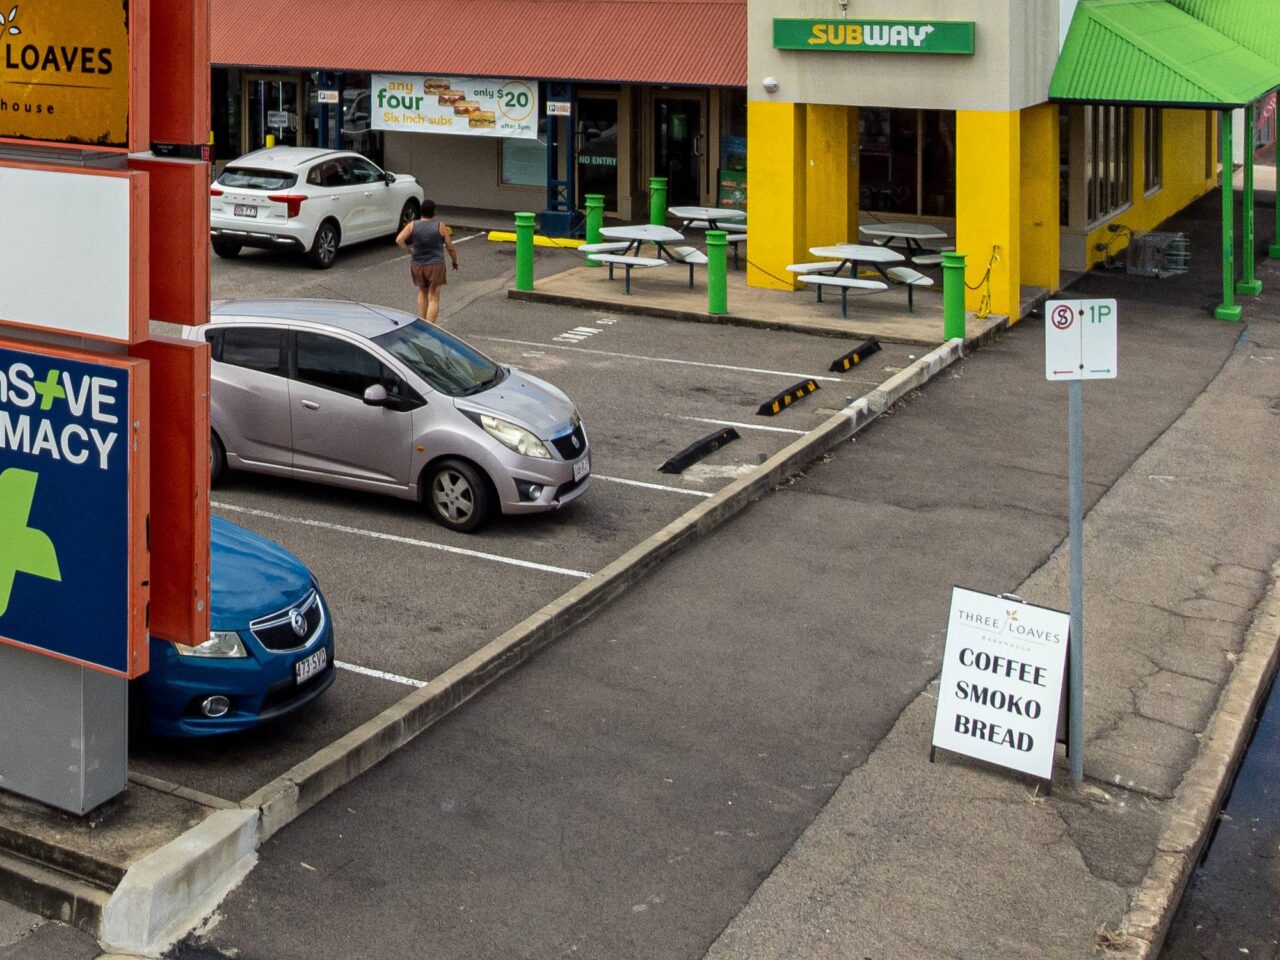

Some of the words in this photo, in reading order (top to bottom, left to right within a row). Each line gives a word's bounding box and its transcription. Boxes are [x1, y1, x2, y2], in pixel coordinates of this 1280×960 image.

[807, 24, 935, 46] SUBWAY
[5, 39, 114, 77] LOAVES
[388, 81, 413, 94] any
[474, 89, 494, 99] only
[497, 89, 529, 108] $20
[377, 89, 424, 111] four
[383, 112, 400, 122] Six
[402, 112, 425, 124] Inch
[428, 115, 453, 126] subs
[579, 156, 590, 164] NO
[592, 157, 617, 165] ENTRY
[1089, 305, 1111, 323] 1P
[958, 609, 1000, 629] THREE
[1009, 623, 1061, 644] LOAVES
[958, 647, 1048, 688] COFFEE
[955, 680, 1042, 720] SMOKO
[954, 713, 1034, 753] BREAD
